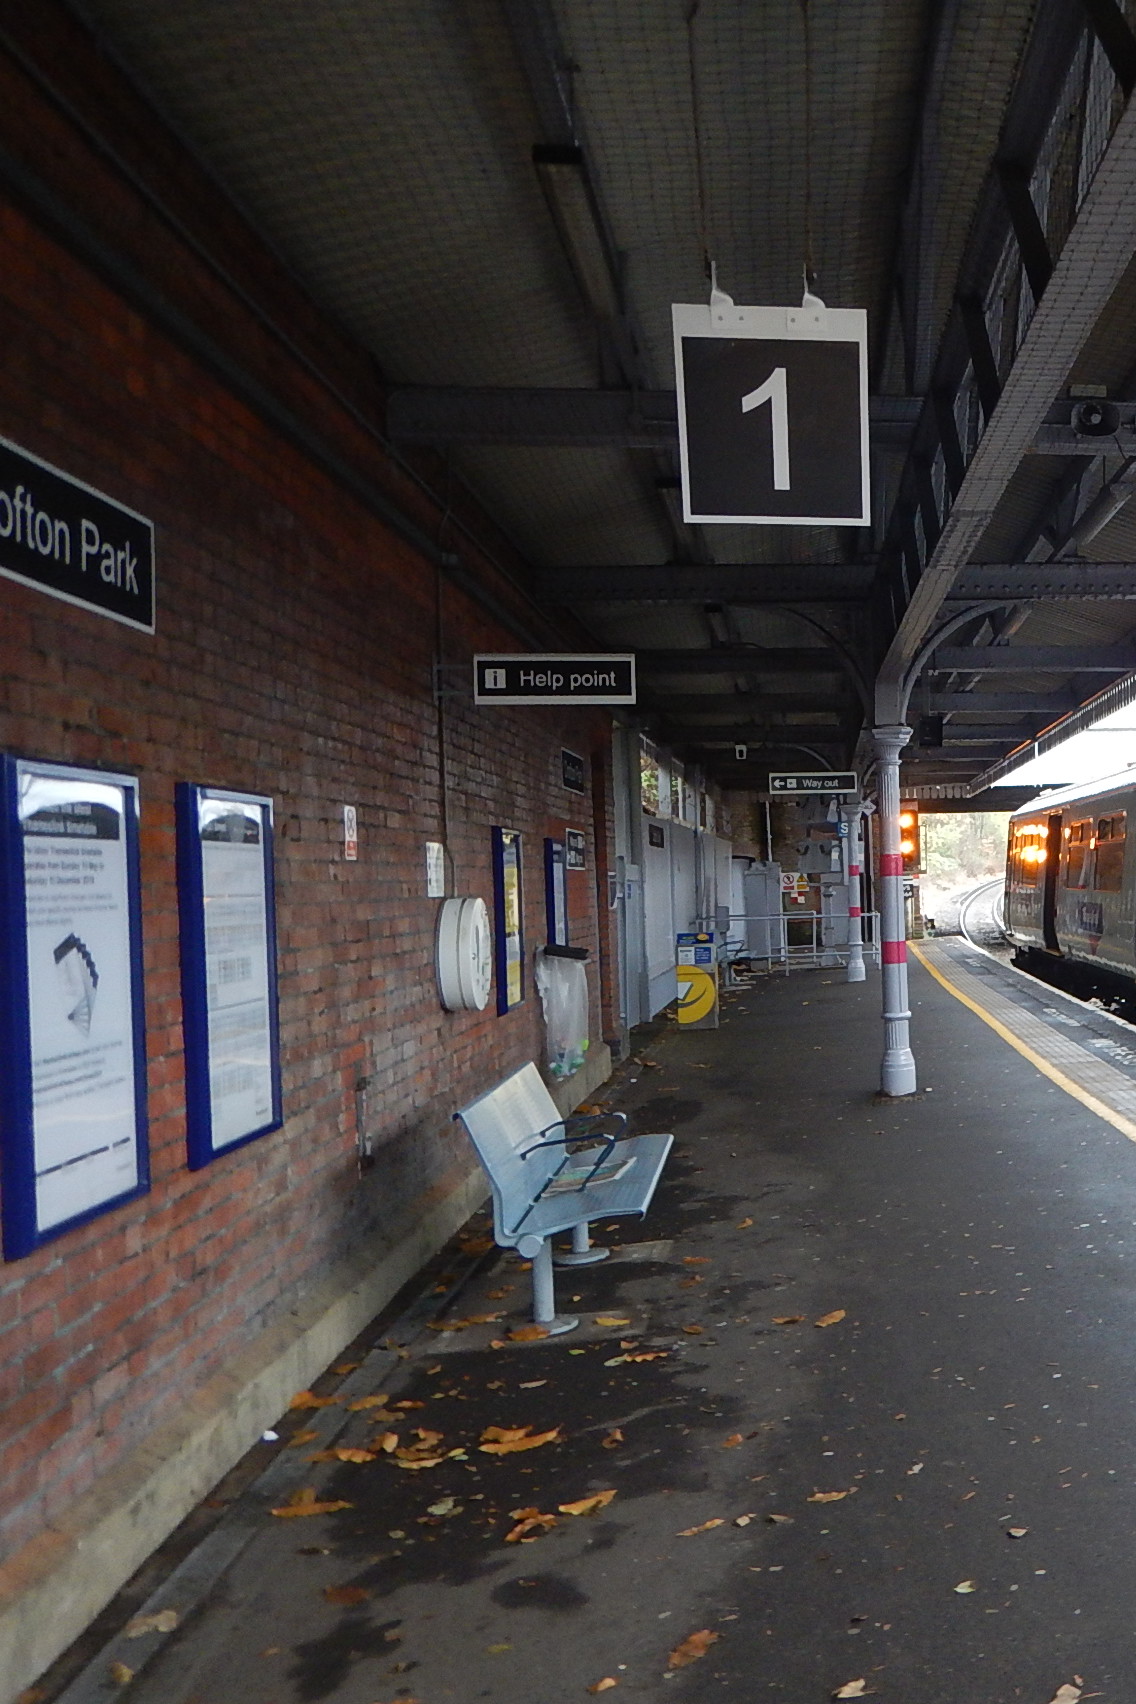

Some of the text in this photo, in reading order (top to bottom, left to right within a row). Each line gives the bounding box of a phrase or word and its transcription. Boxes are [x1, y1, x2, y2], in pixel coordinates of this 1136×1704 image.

[741, 366, 791, 491] 1
[81, 518, 139, 595] Park
[519, 670, 564, 690] Help
[570, 670, 616, 691] point
[802, 779, 839, 789] Way out
